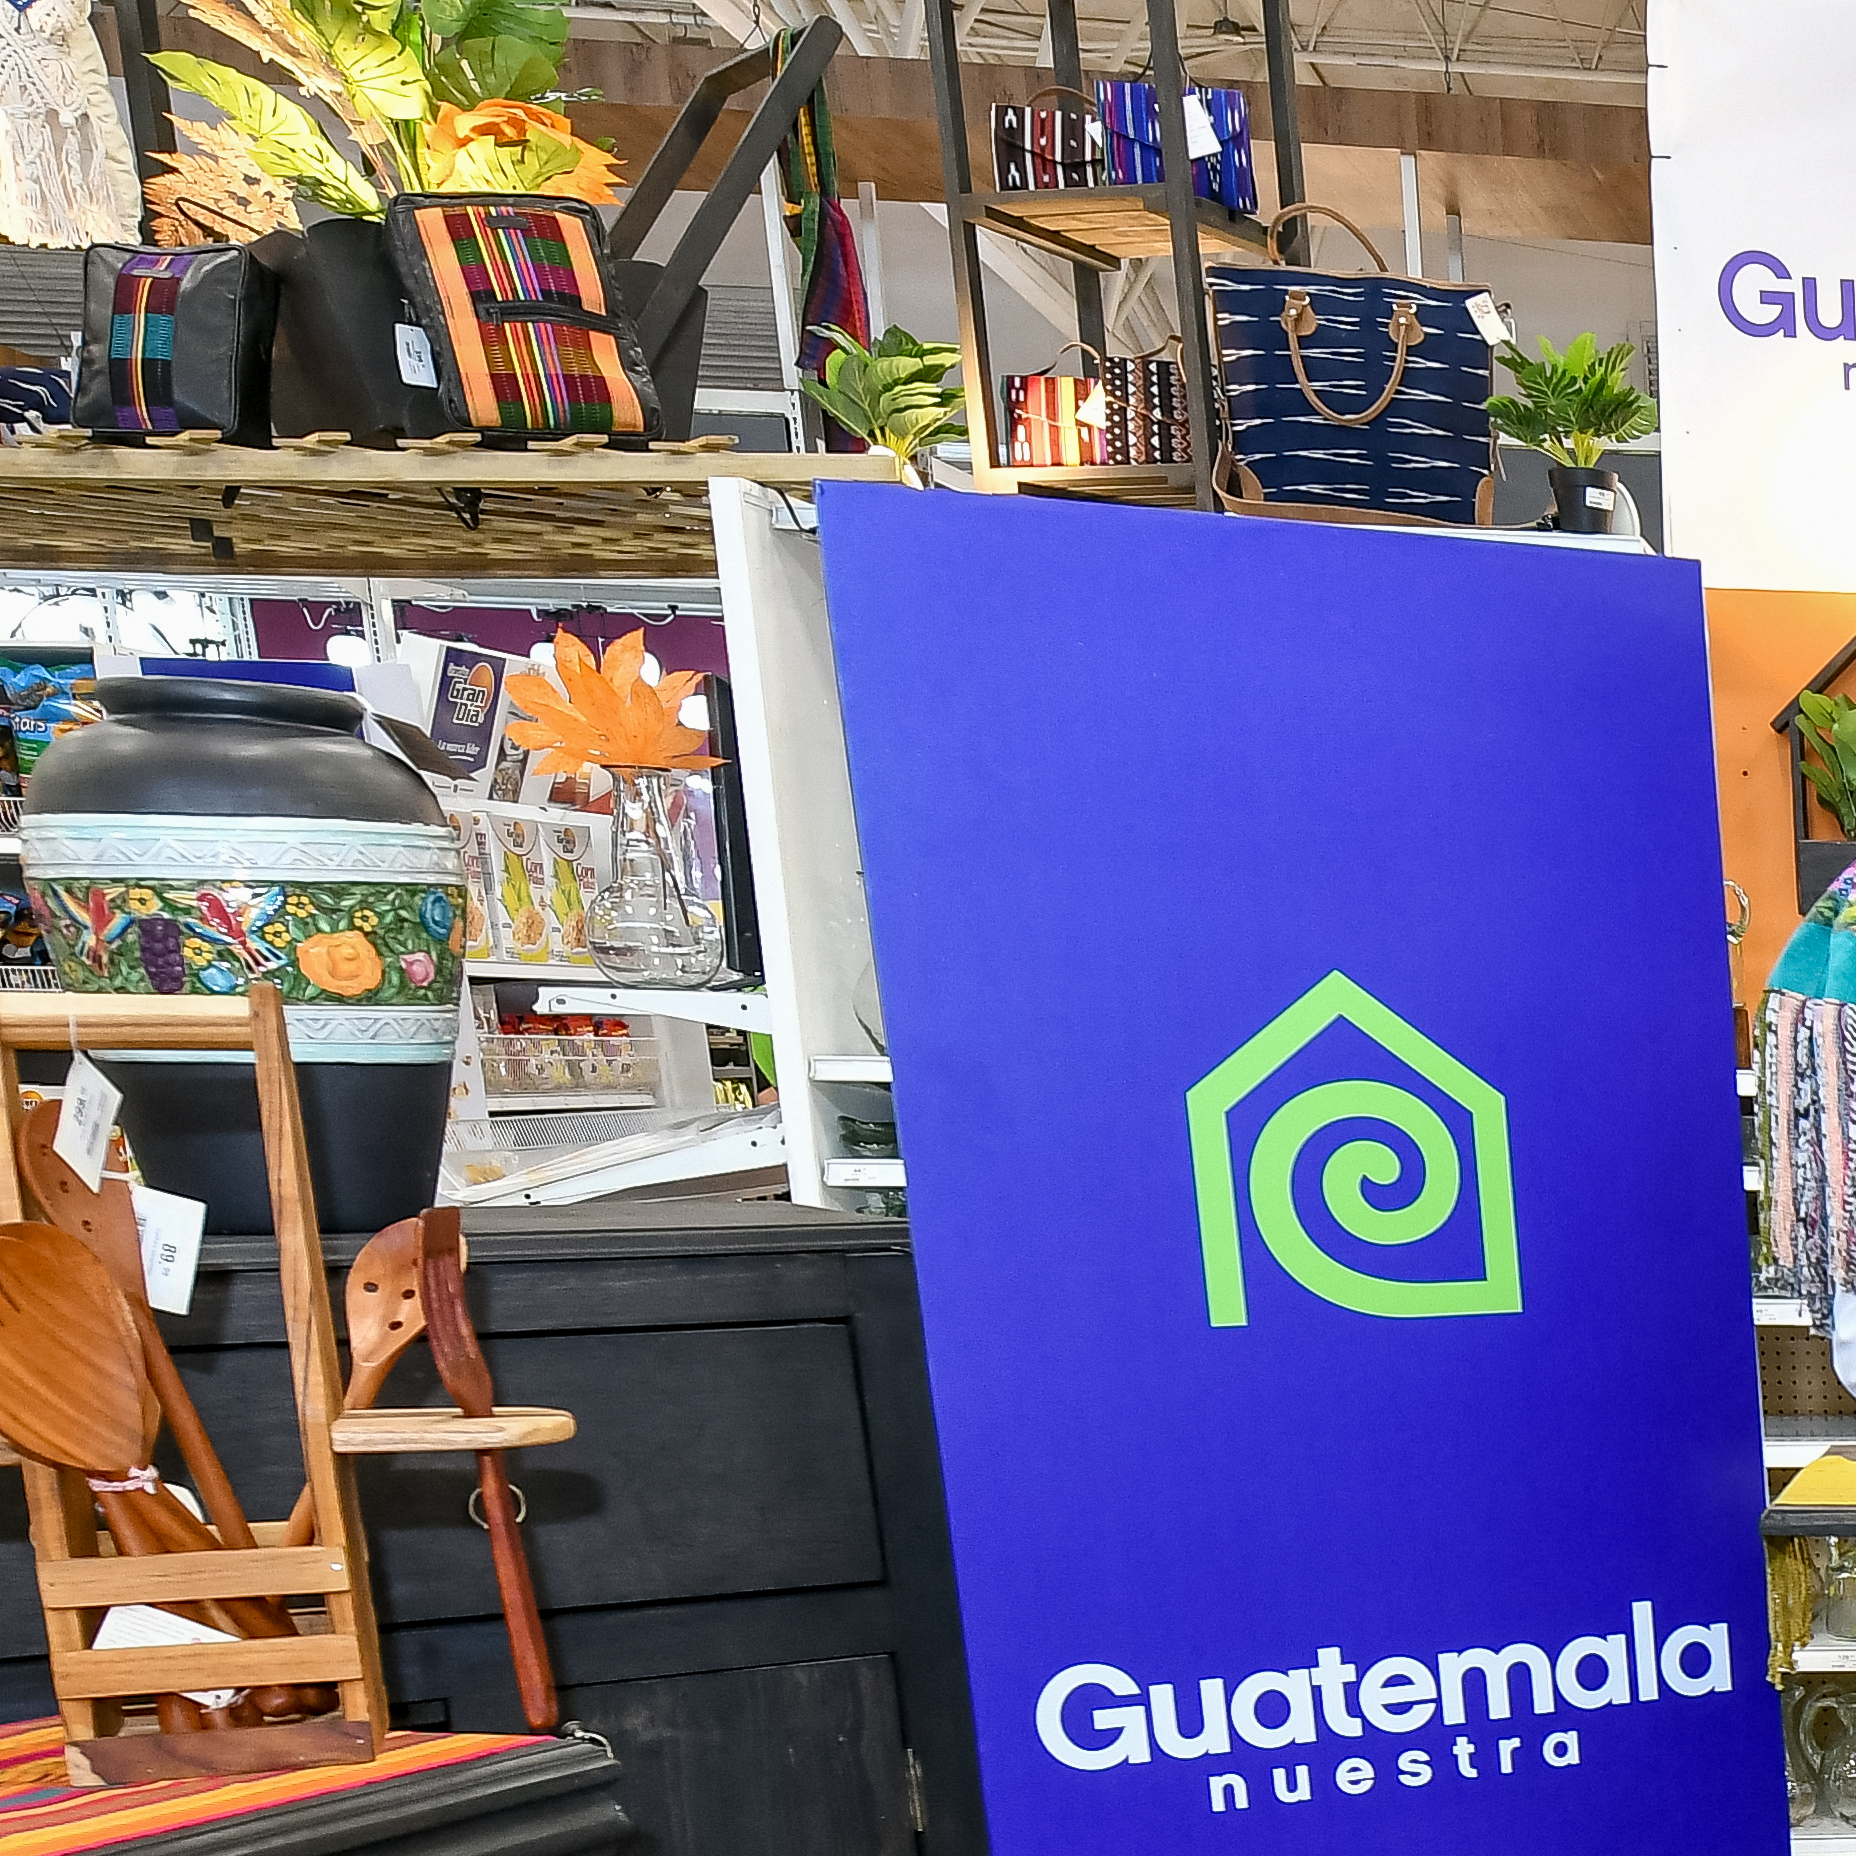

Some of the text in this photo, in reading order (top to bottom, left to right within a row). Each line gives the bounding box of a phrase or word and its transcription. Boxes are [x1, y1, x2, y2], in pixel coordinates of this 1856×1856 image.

[449, 679, 487, 704] Gran
[455, 702, 481, 724] Día
[1035, 1600, 1734, 1771] Guatemala
[1208, 1729, 1582, 1813] nuestra
